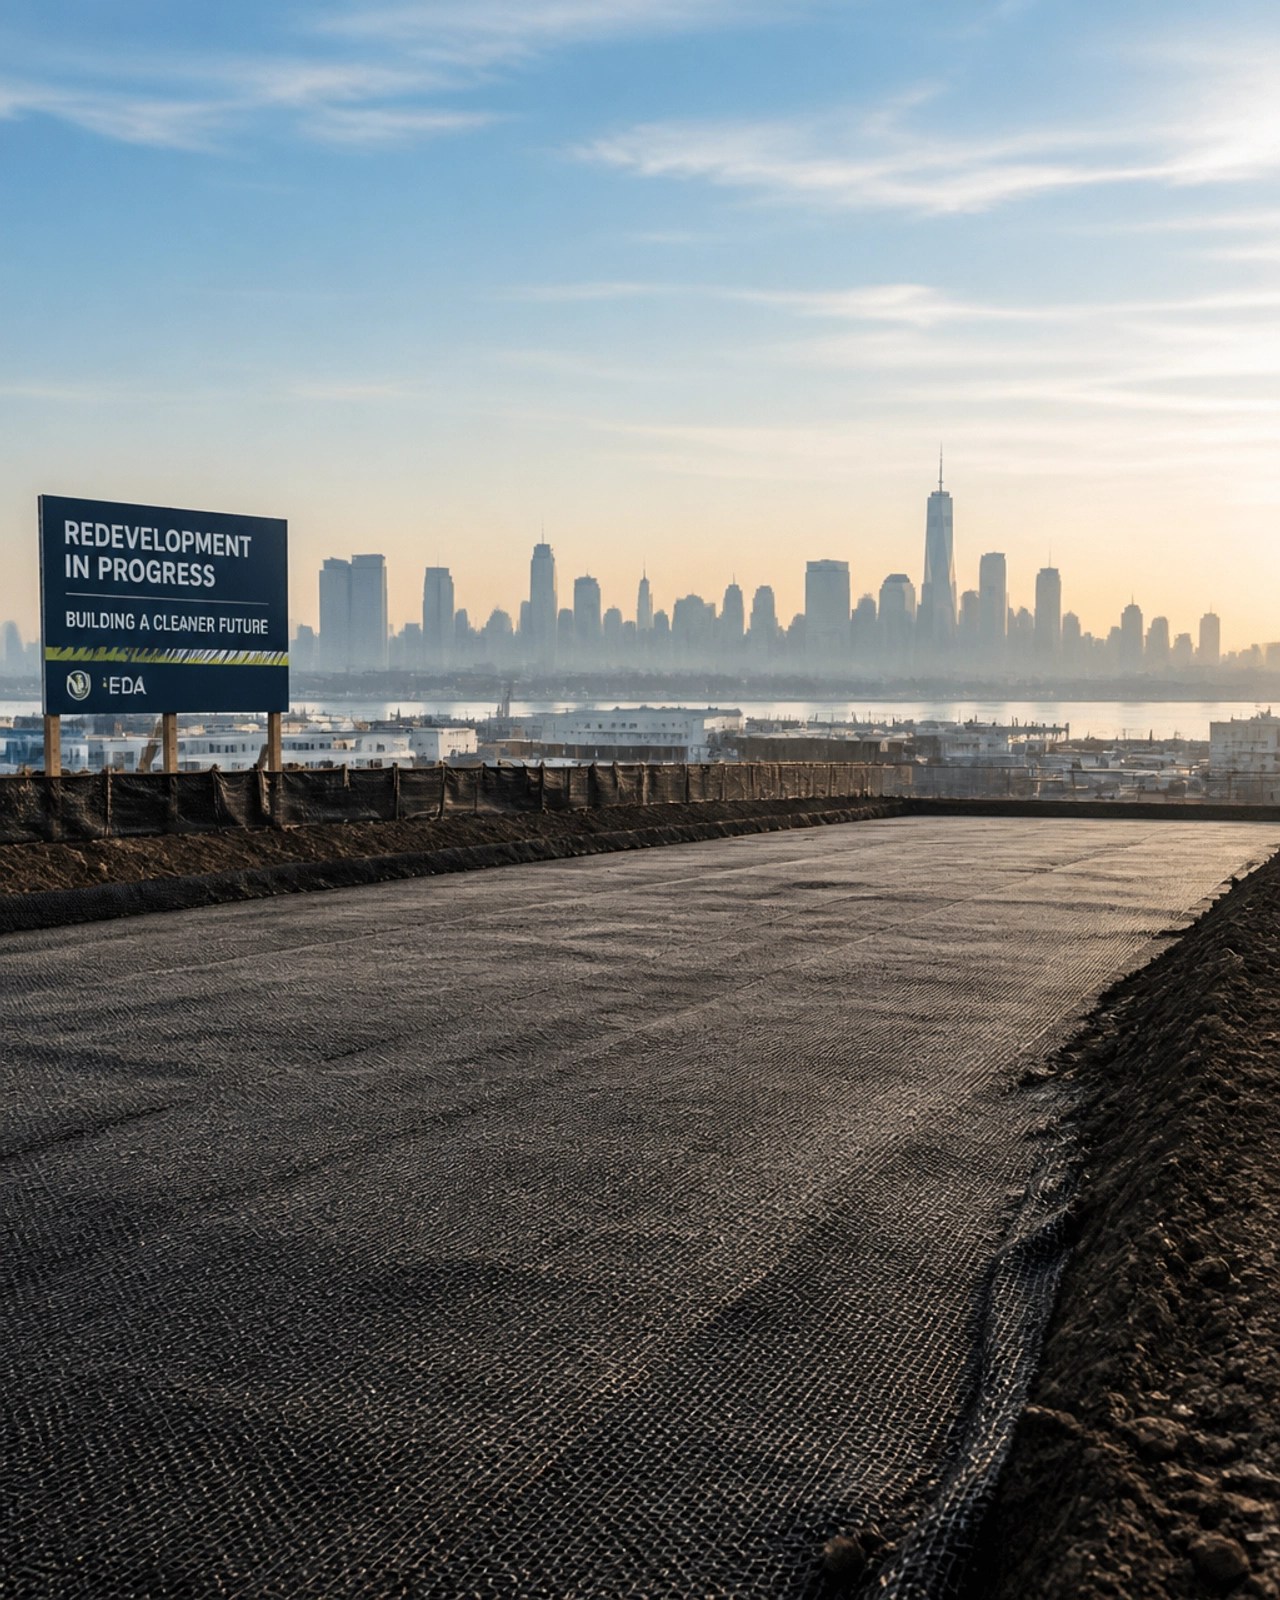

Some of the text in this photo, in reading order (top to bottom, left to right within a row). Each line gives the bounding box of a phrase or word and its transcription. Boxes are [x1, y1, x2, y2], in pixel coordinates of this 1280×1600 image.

[64, 520, 252, 558] REDEVELOPMENT
[65, 554, 216, 588] IN PROGRESS
[66, 611, 269, 635] BUILDING A CLEANER FUTURE
